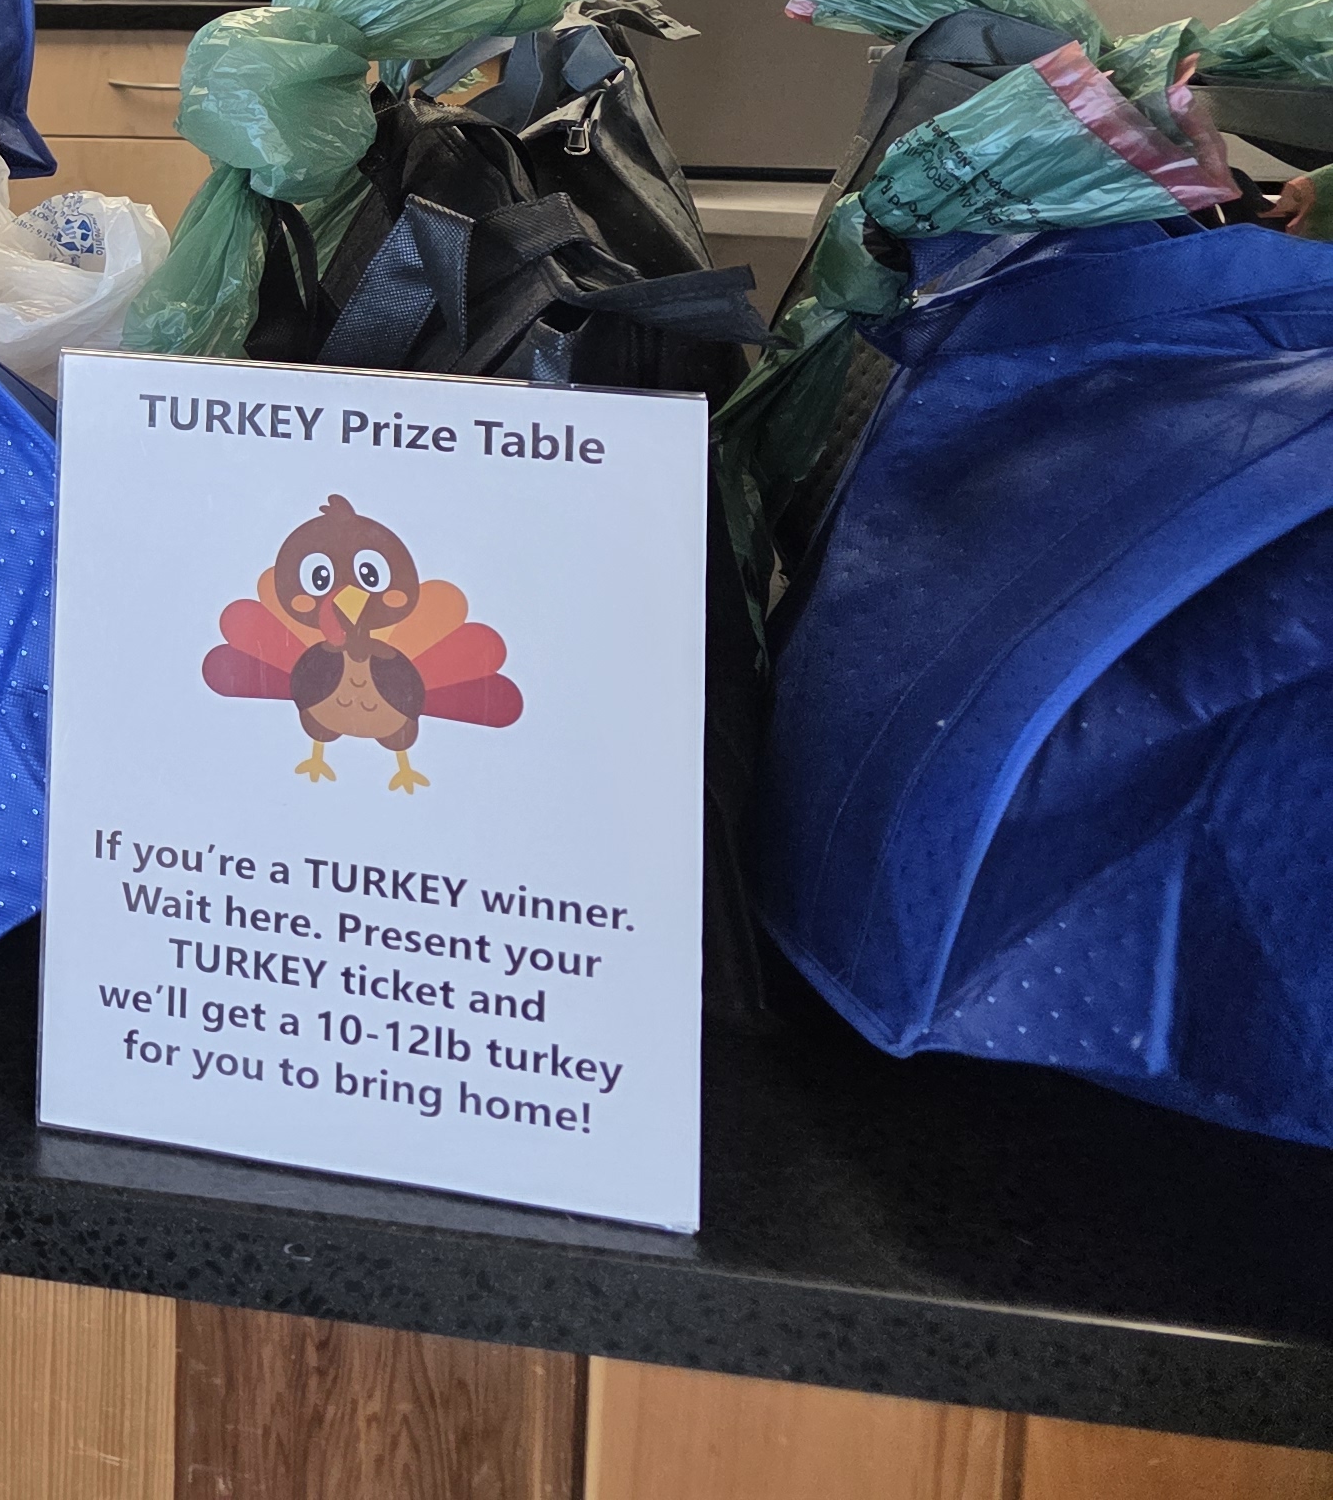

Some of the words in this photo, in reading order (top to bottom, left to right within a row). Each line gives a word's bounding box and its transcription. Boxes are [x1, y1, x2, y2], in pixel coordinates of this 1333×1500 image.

[139, 393, 325, 441] TURKEY
[341, 409, 458, 453] Prize
[473, 419, 606, 465] Table
[95, 829, 123, 861] If
[132, 842, 256, 880] you're
[269, 861, 290, 885] a
[304, 857, 468, 908] TURKEY
[480, 884, 635, 932] winner.
[122, 881, 212, 924] Wait
[225, 894, 322, 940] here.
[338, 912, 491, 964] Present
[504, 943, 603, 978] your
[168, 937, 328, 989] TURKEY
[340, 964, 455, 1010] ticket
[468, 989, 546, 1023] and
[98, 984, 187, 1019] we'll
[201, 1001, 267, 1033] get
[279, 1013, 300, 1037] a
[317, 1010, 471, 1062] 10-12lb
[485, 1039, 624, 1094] turkey
[122, 1029, 181, 1066] for
[192, 1048, 264, 1082] you
[278, 1058, 320, 1090] to
[335, 1061, 442, 1118] bring
[459, 1080, 591, 1134] home!
